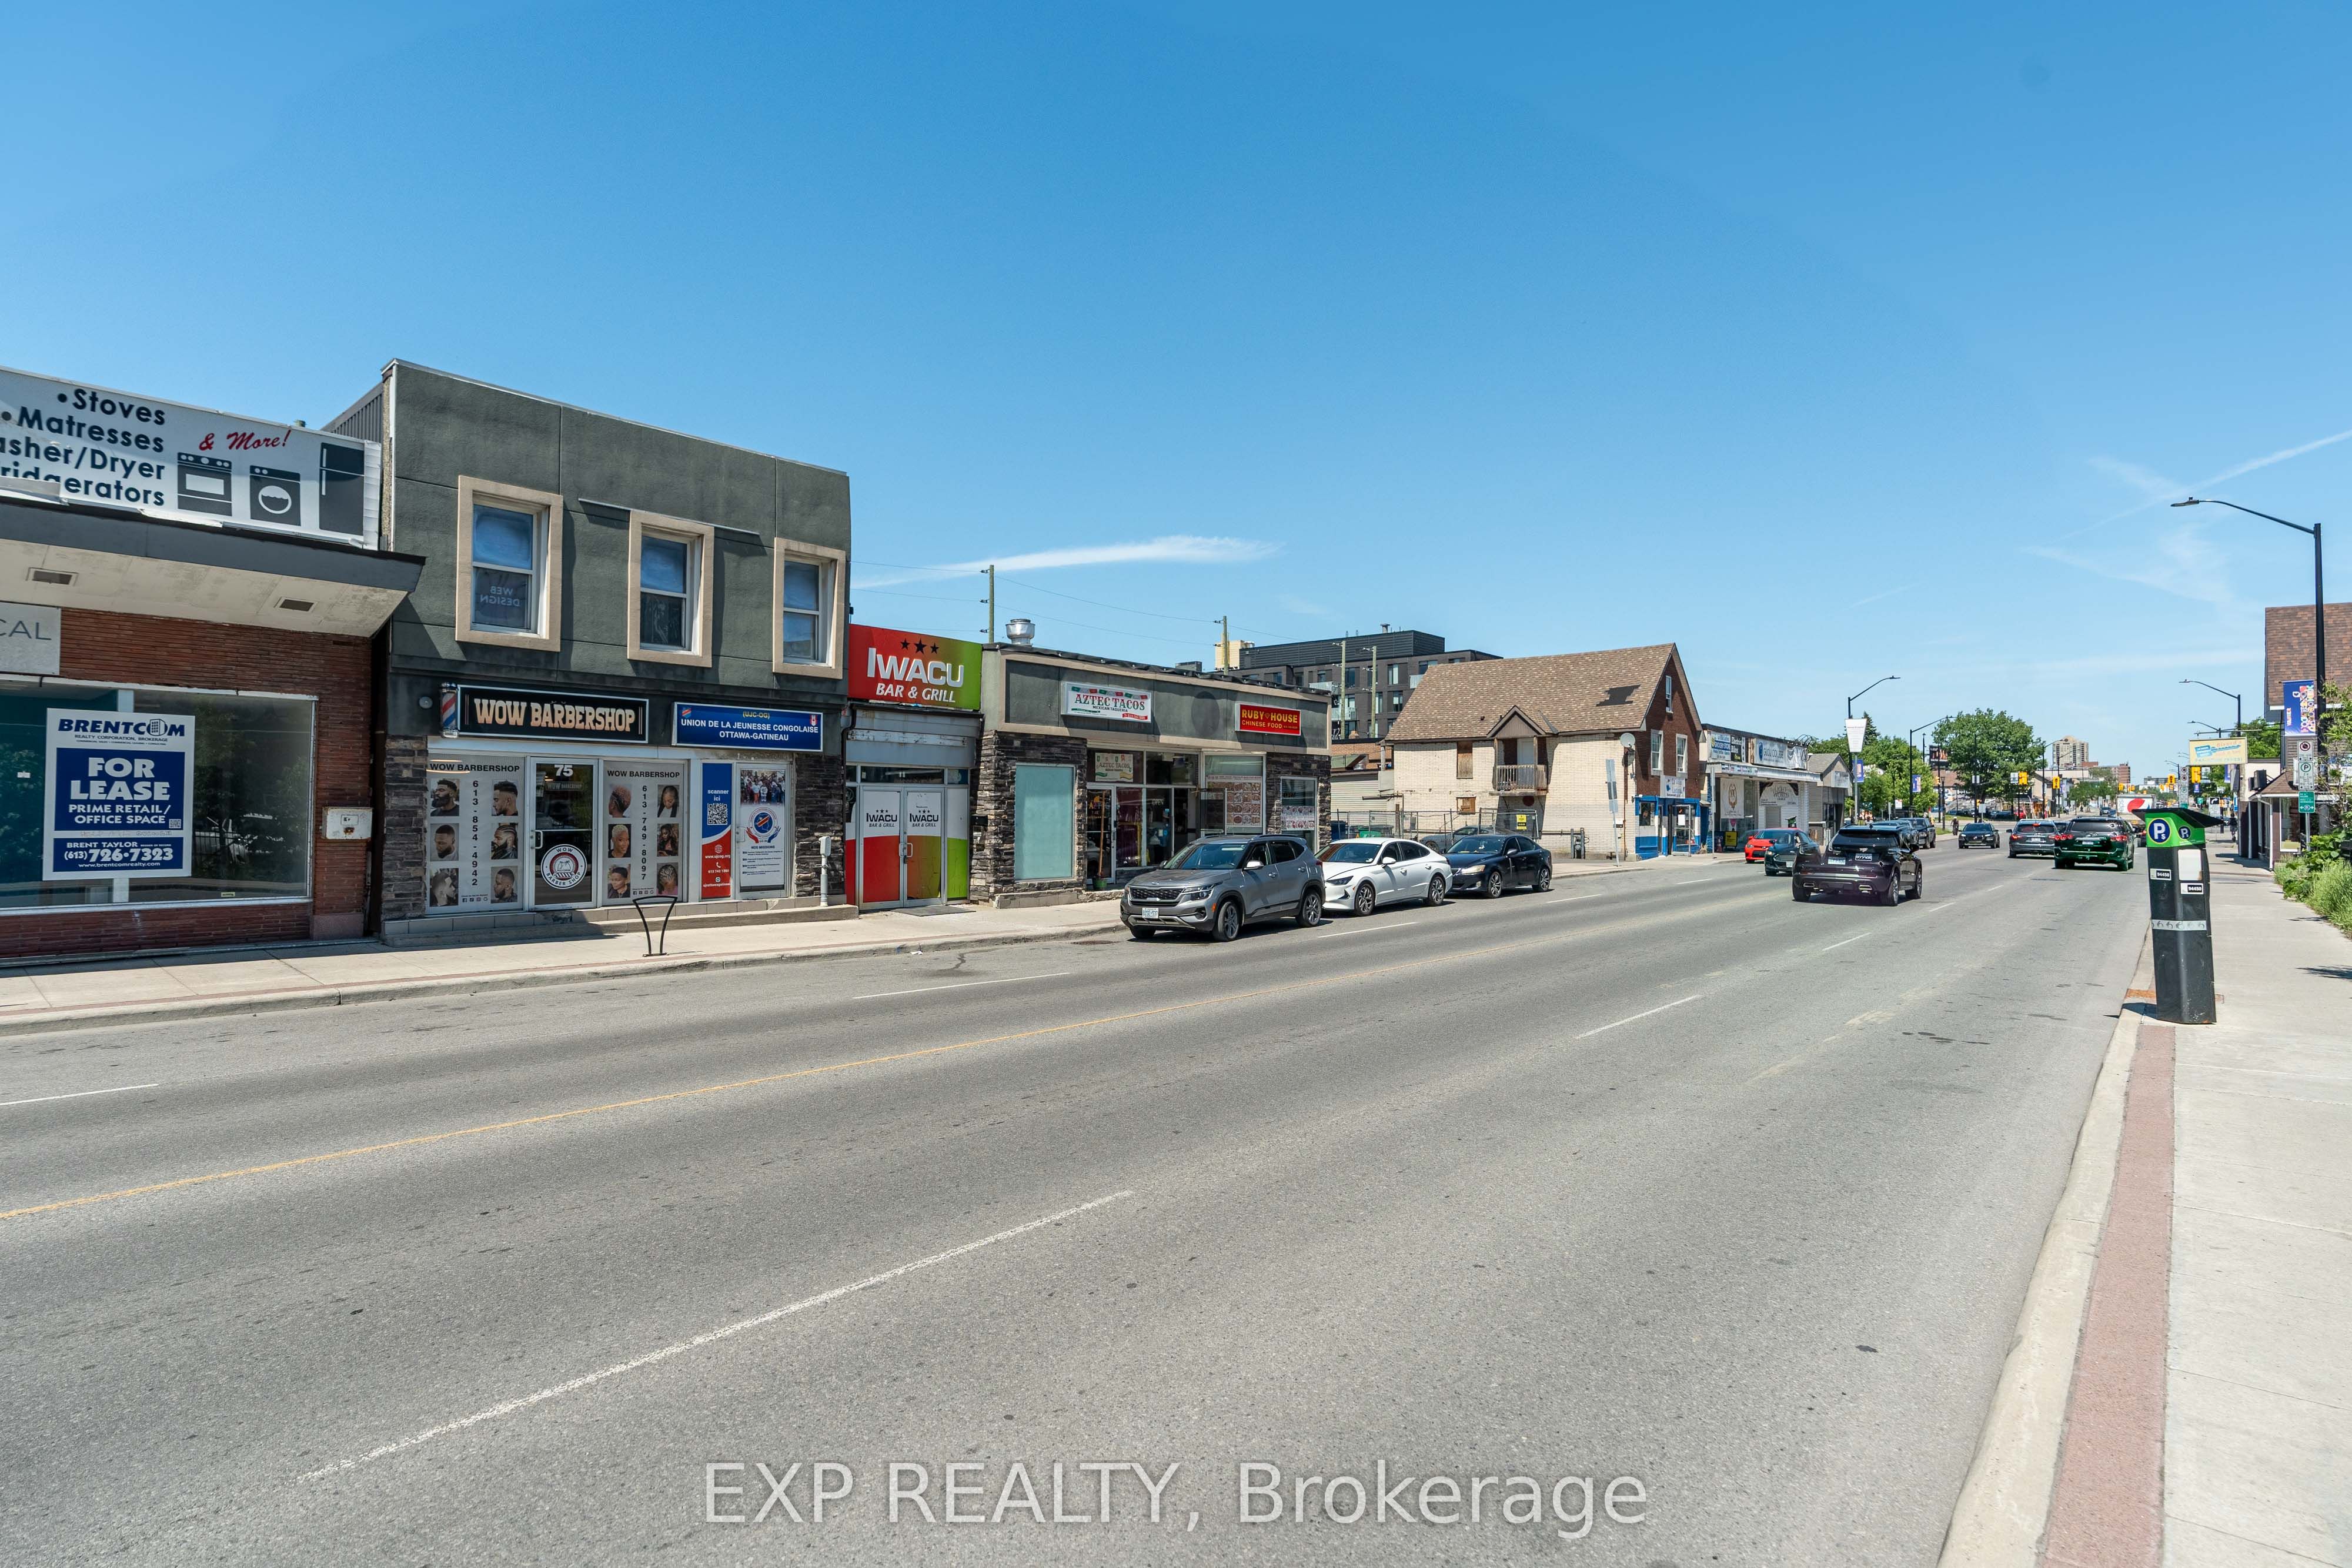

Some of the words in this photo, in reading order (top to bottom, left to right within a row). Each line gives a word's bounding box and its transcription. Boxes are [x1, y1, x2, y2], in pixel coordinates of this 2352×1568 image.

[18, 406, 164, 452] Matresses
[199, 433, 215, 452] &
[226, 429, 291, 450] More!
[867, 647, 964, 687] IWACU
[876, 683, 904, 698] BAR
[908, 686, 917, 698] &
[922, 688, 956, 703] GRILL
[1075, 694, 1110, 707] AZTEC
[1112, 698, 1145, 711] TACOS
[474, 698, 527, 726] WOW
[530, 703, 635, 732] BARBERSHOP
[743, 711, 770, 720] (UJC-OG)
[1242, 709, 1264, 720] RUBY
[1271, 713, 1298, 723] HOUSE
[58, 718, 185, 736] BRENTCOM
[681, 718, 706, 727] UNION
[733, 722, 771, 731] JEUNESSE
[773, 724, 818, 733] CONGOLAISE
[719, 731, 789, 741] OTTAWA-GATINEAU
[88, 757, 155, 778] FOR
[457, 764, 520, 772] BARBERSHOP
[554, 764, 573, 777] 75
[70, 780, 171, 800] LEASE
[69, 804, 111, 813] PRIME
[866, 813, 897, 822] IWACU
[910, 813, 939, 822] IWACU
[64, 851, 88, 860] (613)
[546, 872, 566, 886] BARBER
[569, 872, 581, 885] SHOP
